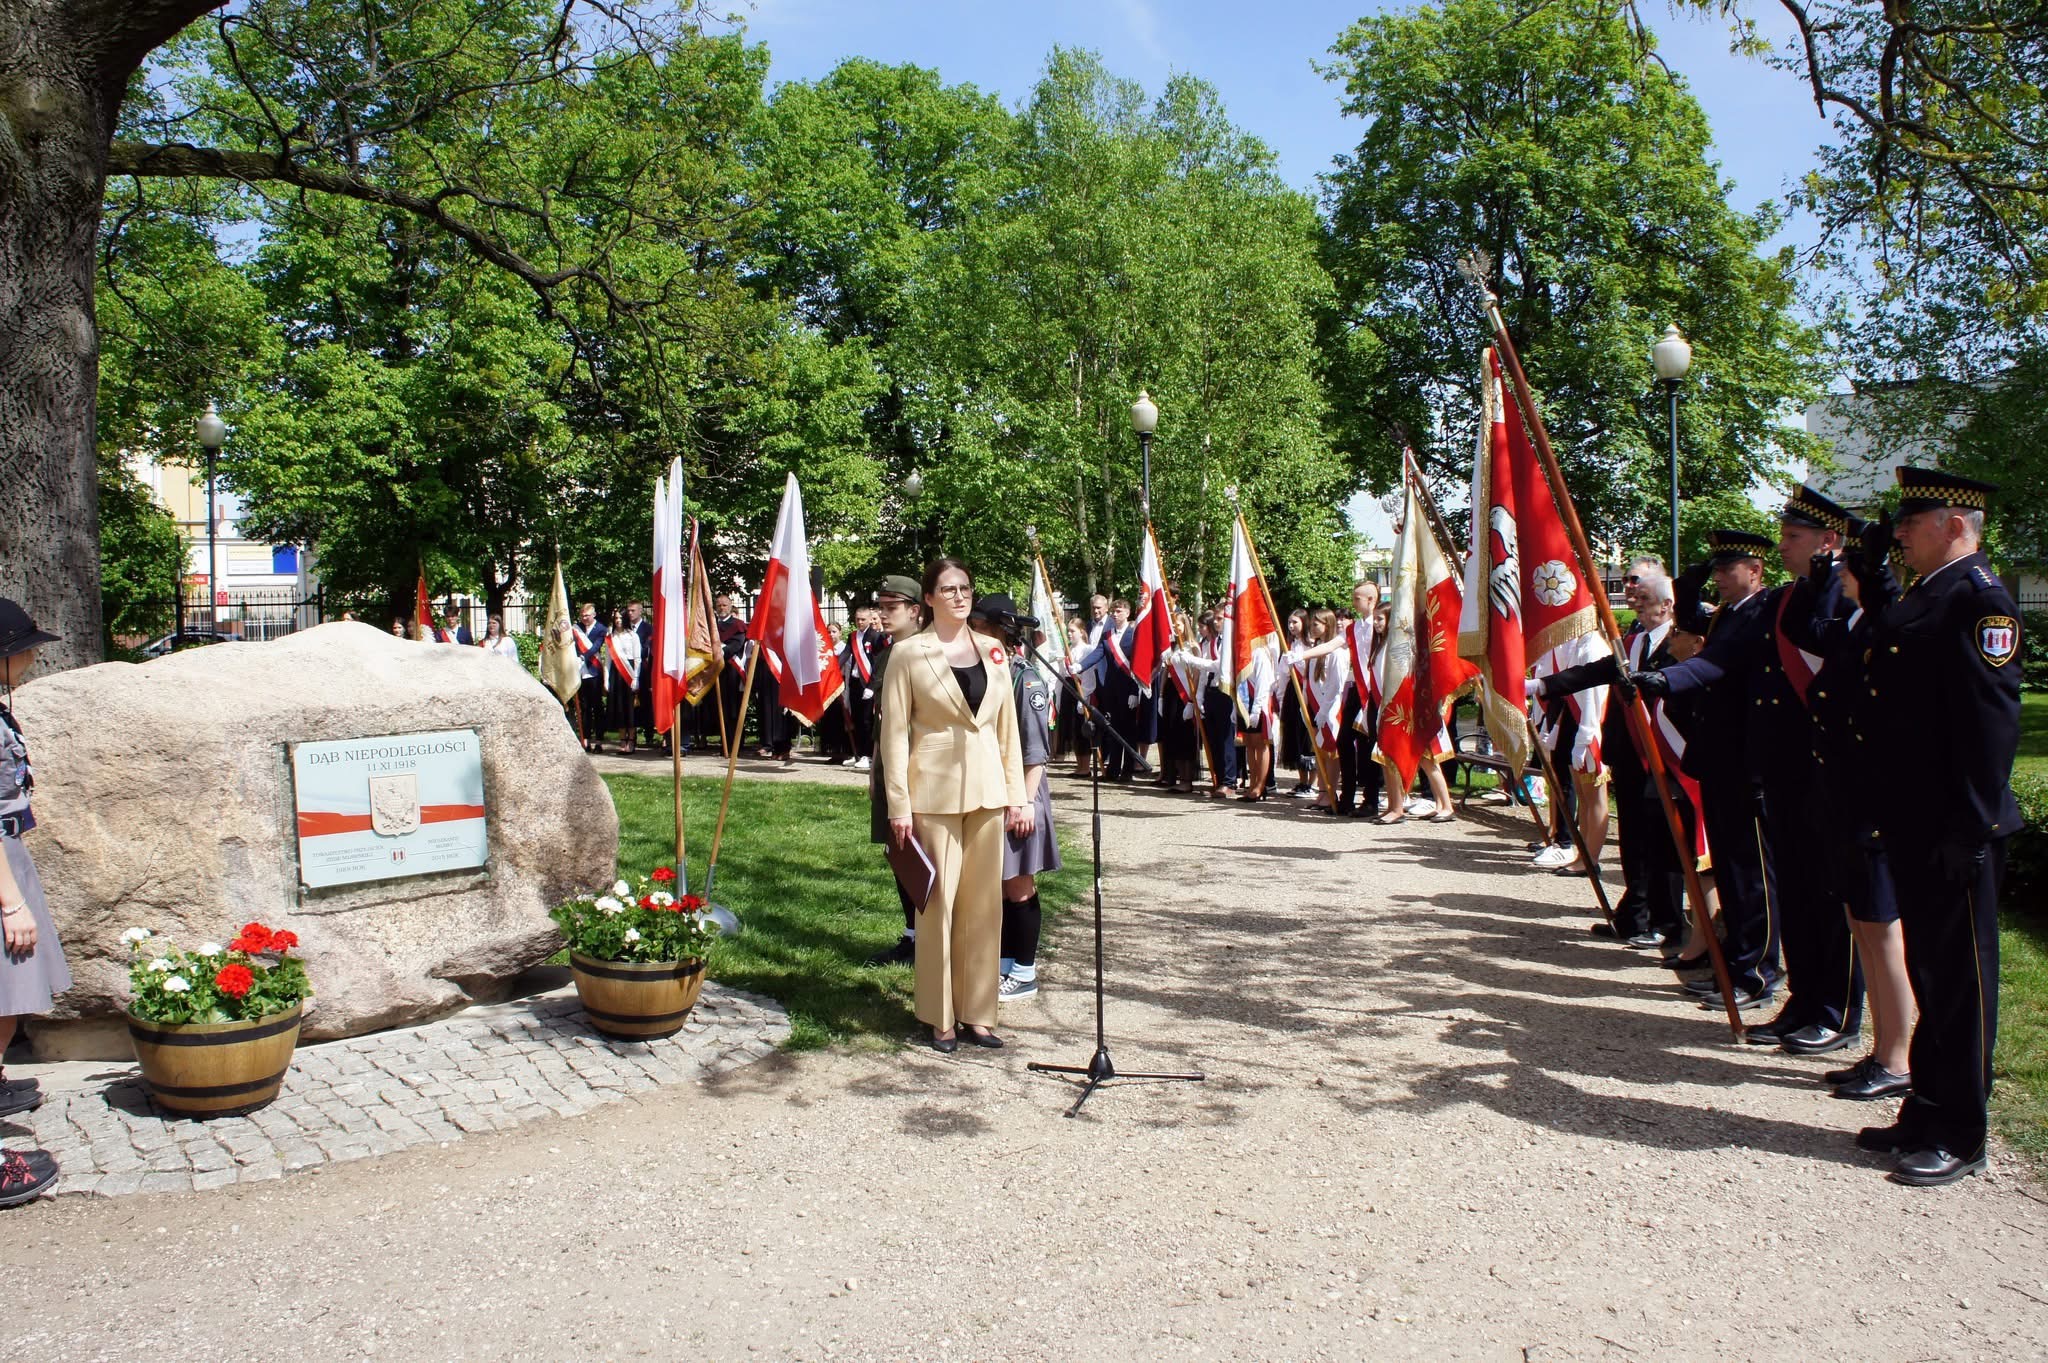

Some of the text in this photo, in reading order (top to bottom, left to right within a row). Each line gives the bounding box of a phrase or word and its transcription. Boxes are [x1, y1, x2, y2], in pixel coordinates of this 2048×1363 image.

[310, 741, 466, 765] DĄB NIEPODLEGŁOŚCI
[367, 760, 417, 772] 11 XI 1918
